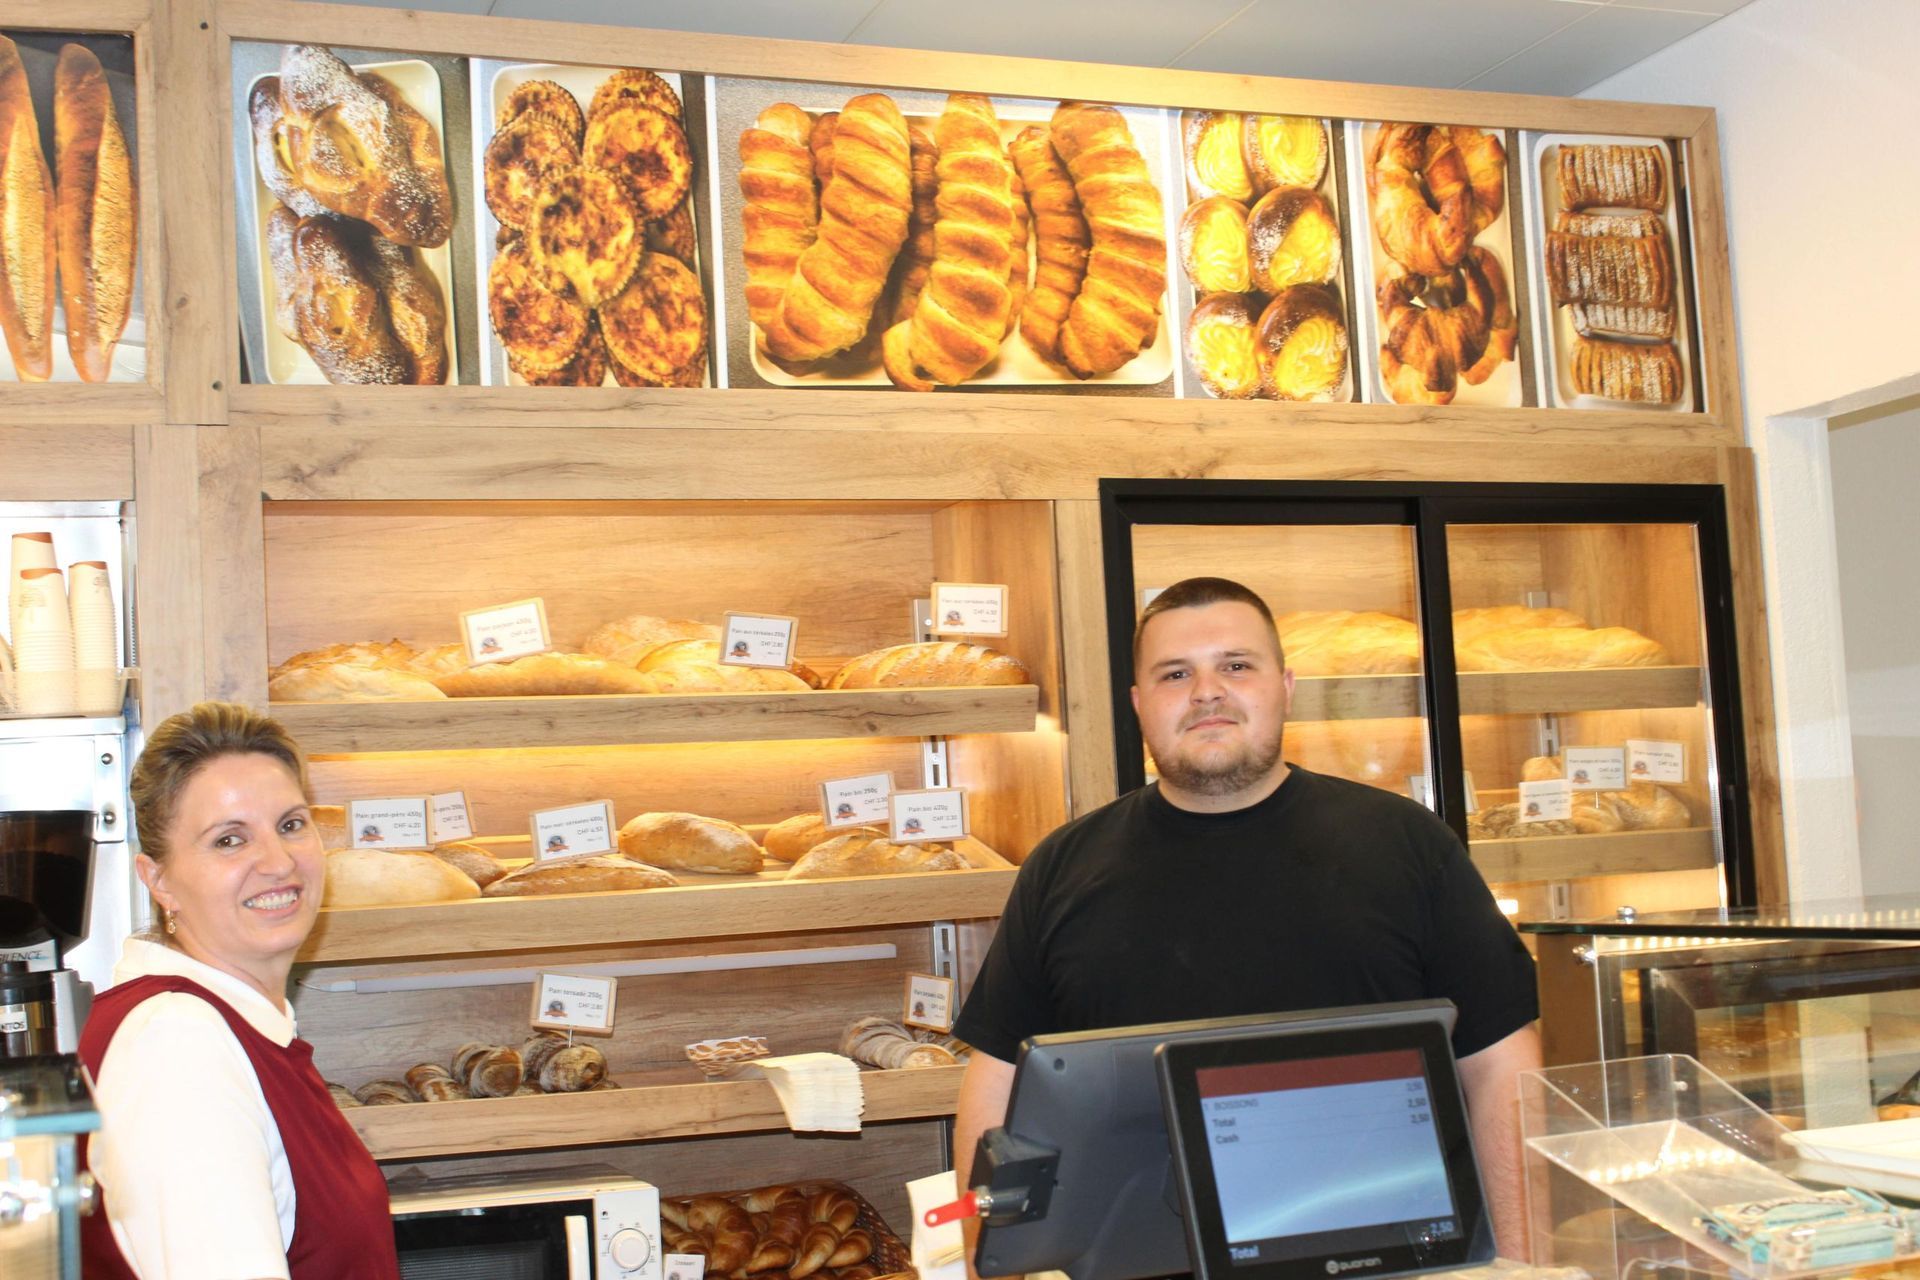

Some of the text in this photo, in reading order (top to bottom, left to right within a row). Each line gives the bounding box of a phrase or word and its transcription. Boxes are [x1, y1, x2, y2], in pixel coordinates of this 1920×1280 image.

[587, 991, 602, 999] 250g
[1213, 1118, 1236, 1127] Total
[1216, 1134, 1239, 1144] Cash
[1229, 1246, 1260, 1259] Total
